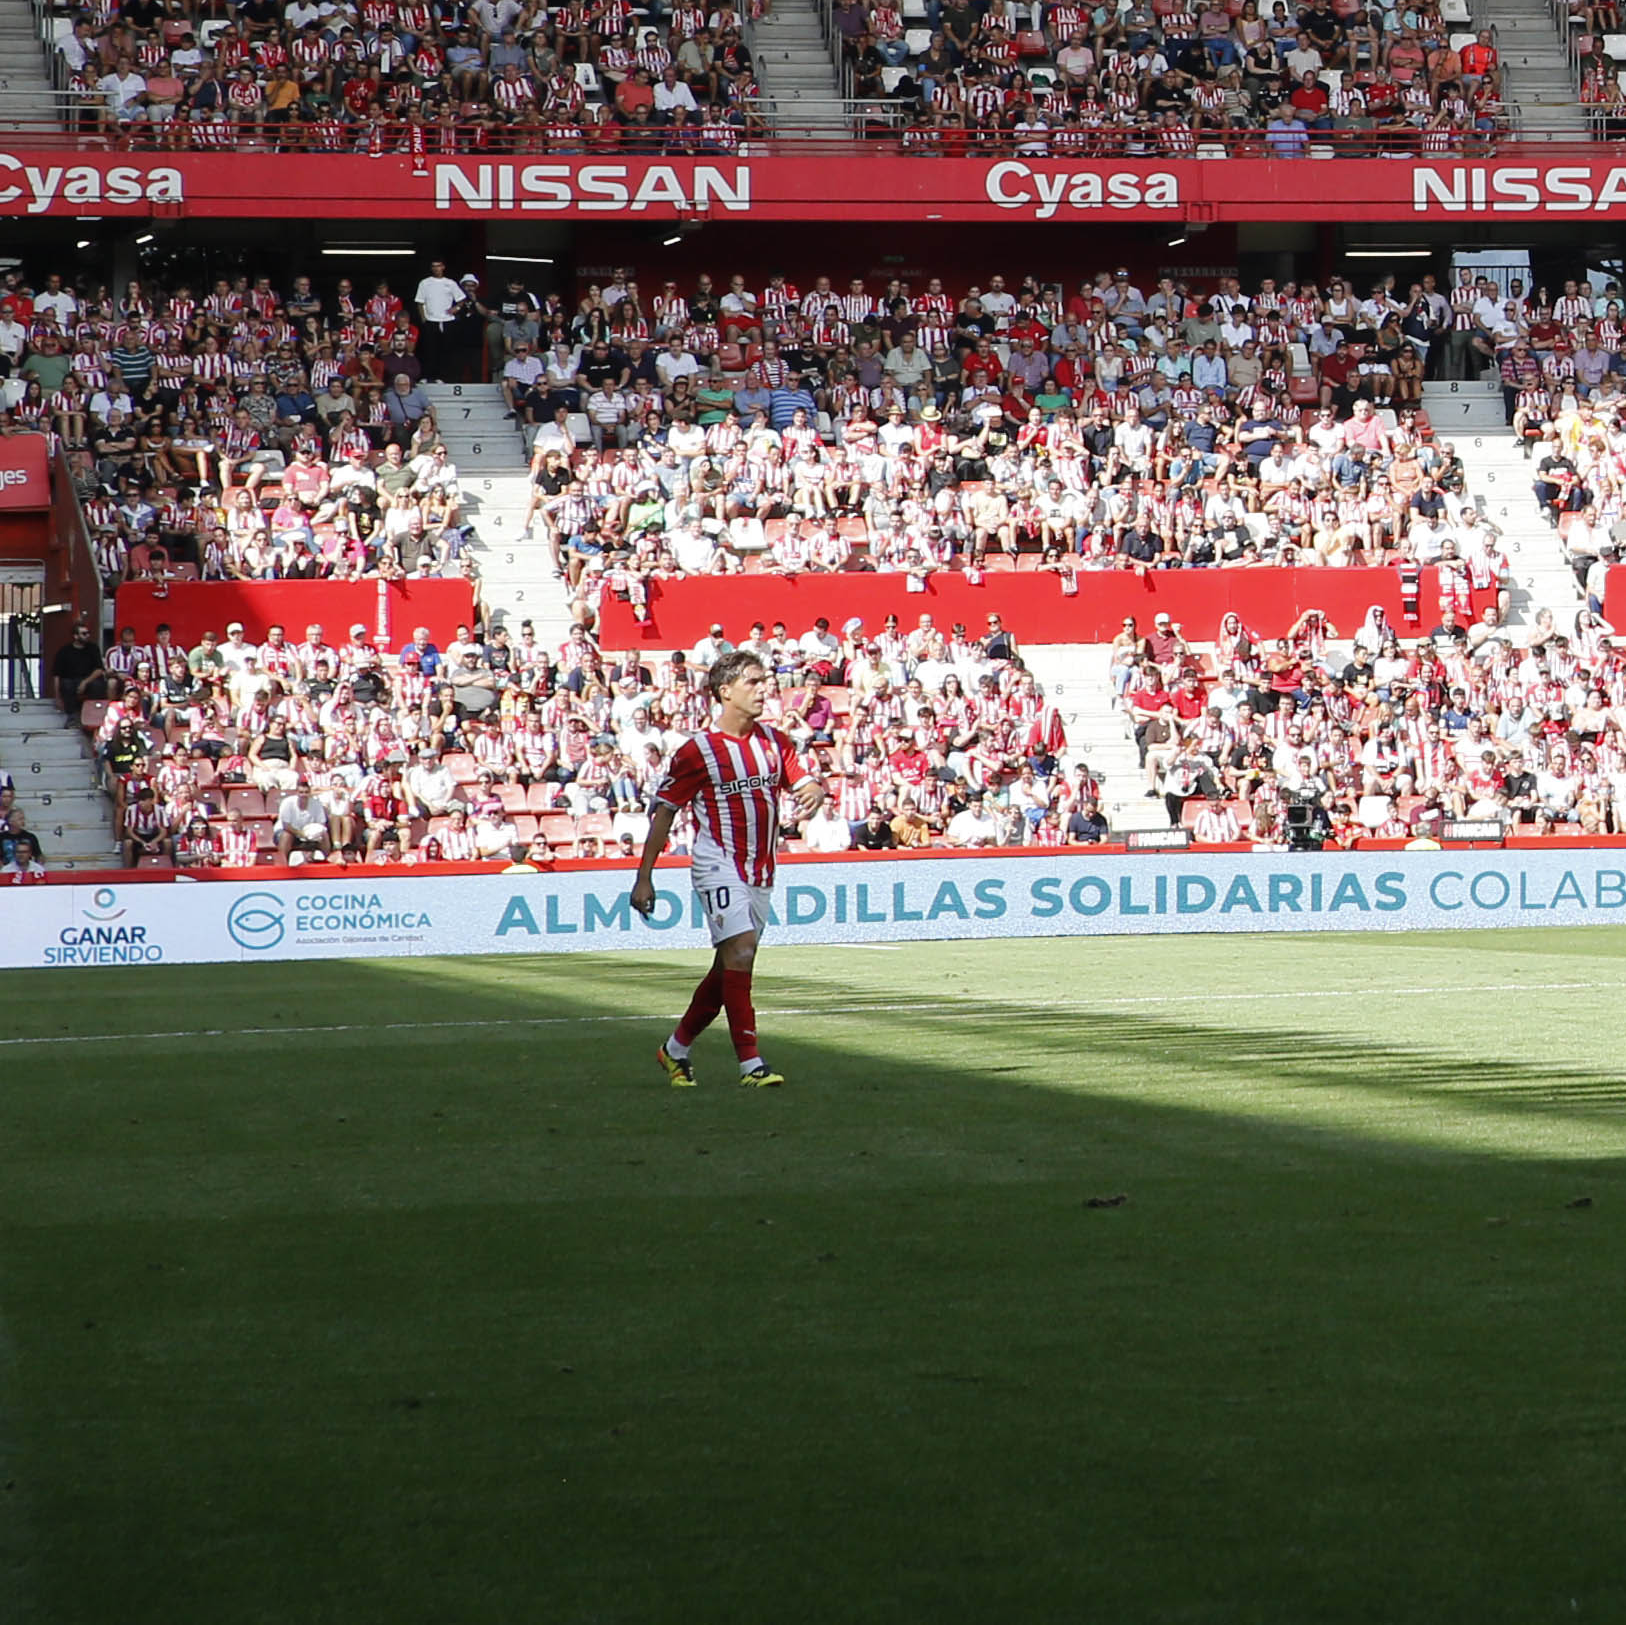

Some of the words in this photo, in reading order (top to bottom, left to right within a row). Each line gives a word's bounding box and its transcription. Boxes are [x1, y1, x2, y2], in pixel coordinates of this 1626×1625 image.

[436, 165, 749, 210] NISSAN
[986, 161, 1178, 218] Cyasa
[296, 894, 382, 912] COCINA
[496, 880, 1006, 937] ALMODILLAS
[1031, 872, 1407, 917] SOLIDARIAS
[705, 886, 730, 914] 10
[296, 909, 431, 931] ECONÓMICA
[60, 927, 147, 946] GANAR
[43, 944, 163, 966] SIRVIENDO
